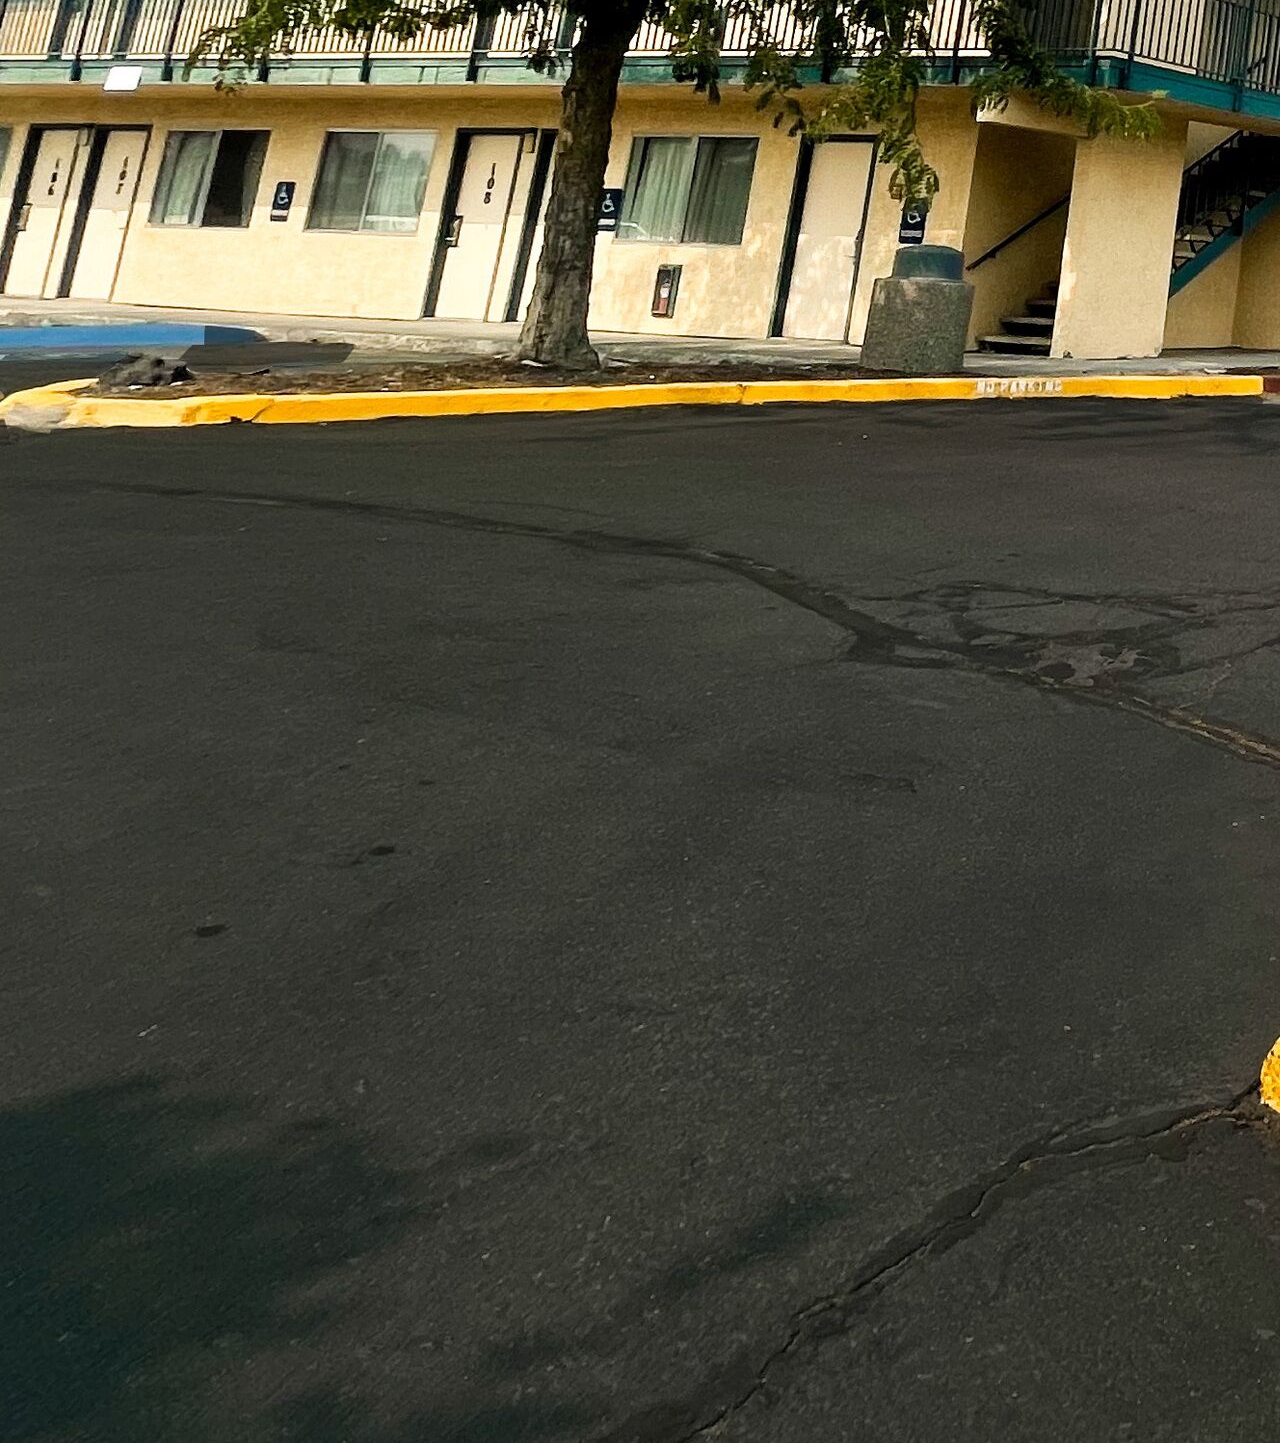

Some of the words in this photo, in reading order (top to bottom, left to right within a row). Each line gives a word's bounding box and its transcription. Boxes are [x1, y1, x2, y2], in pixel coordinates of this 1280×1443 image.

[483, 162, 497, 204] 108
[976, 379, 995, 394] NO
[1000, 378, 1062, 393] PARKING
